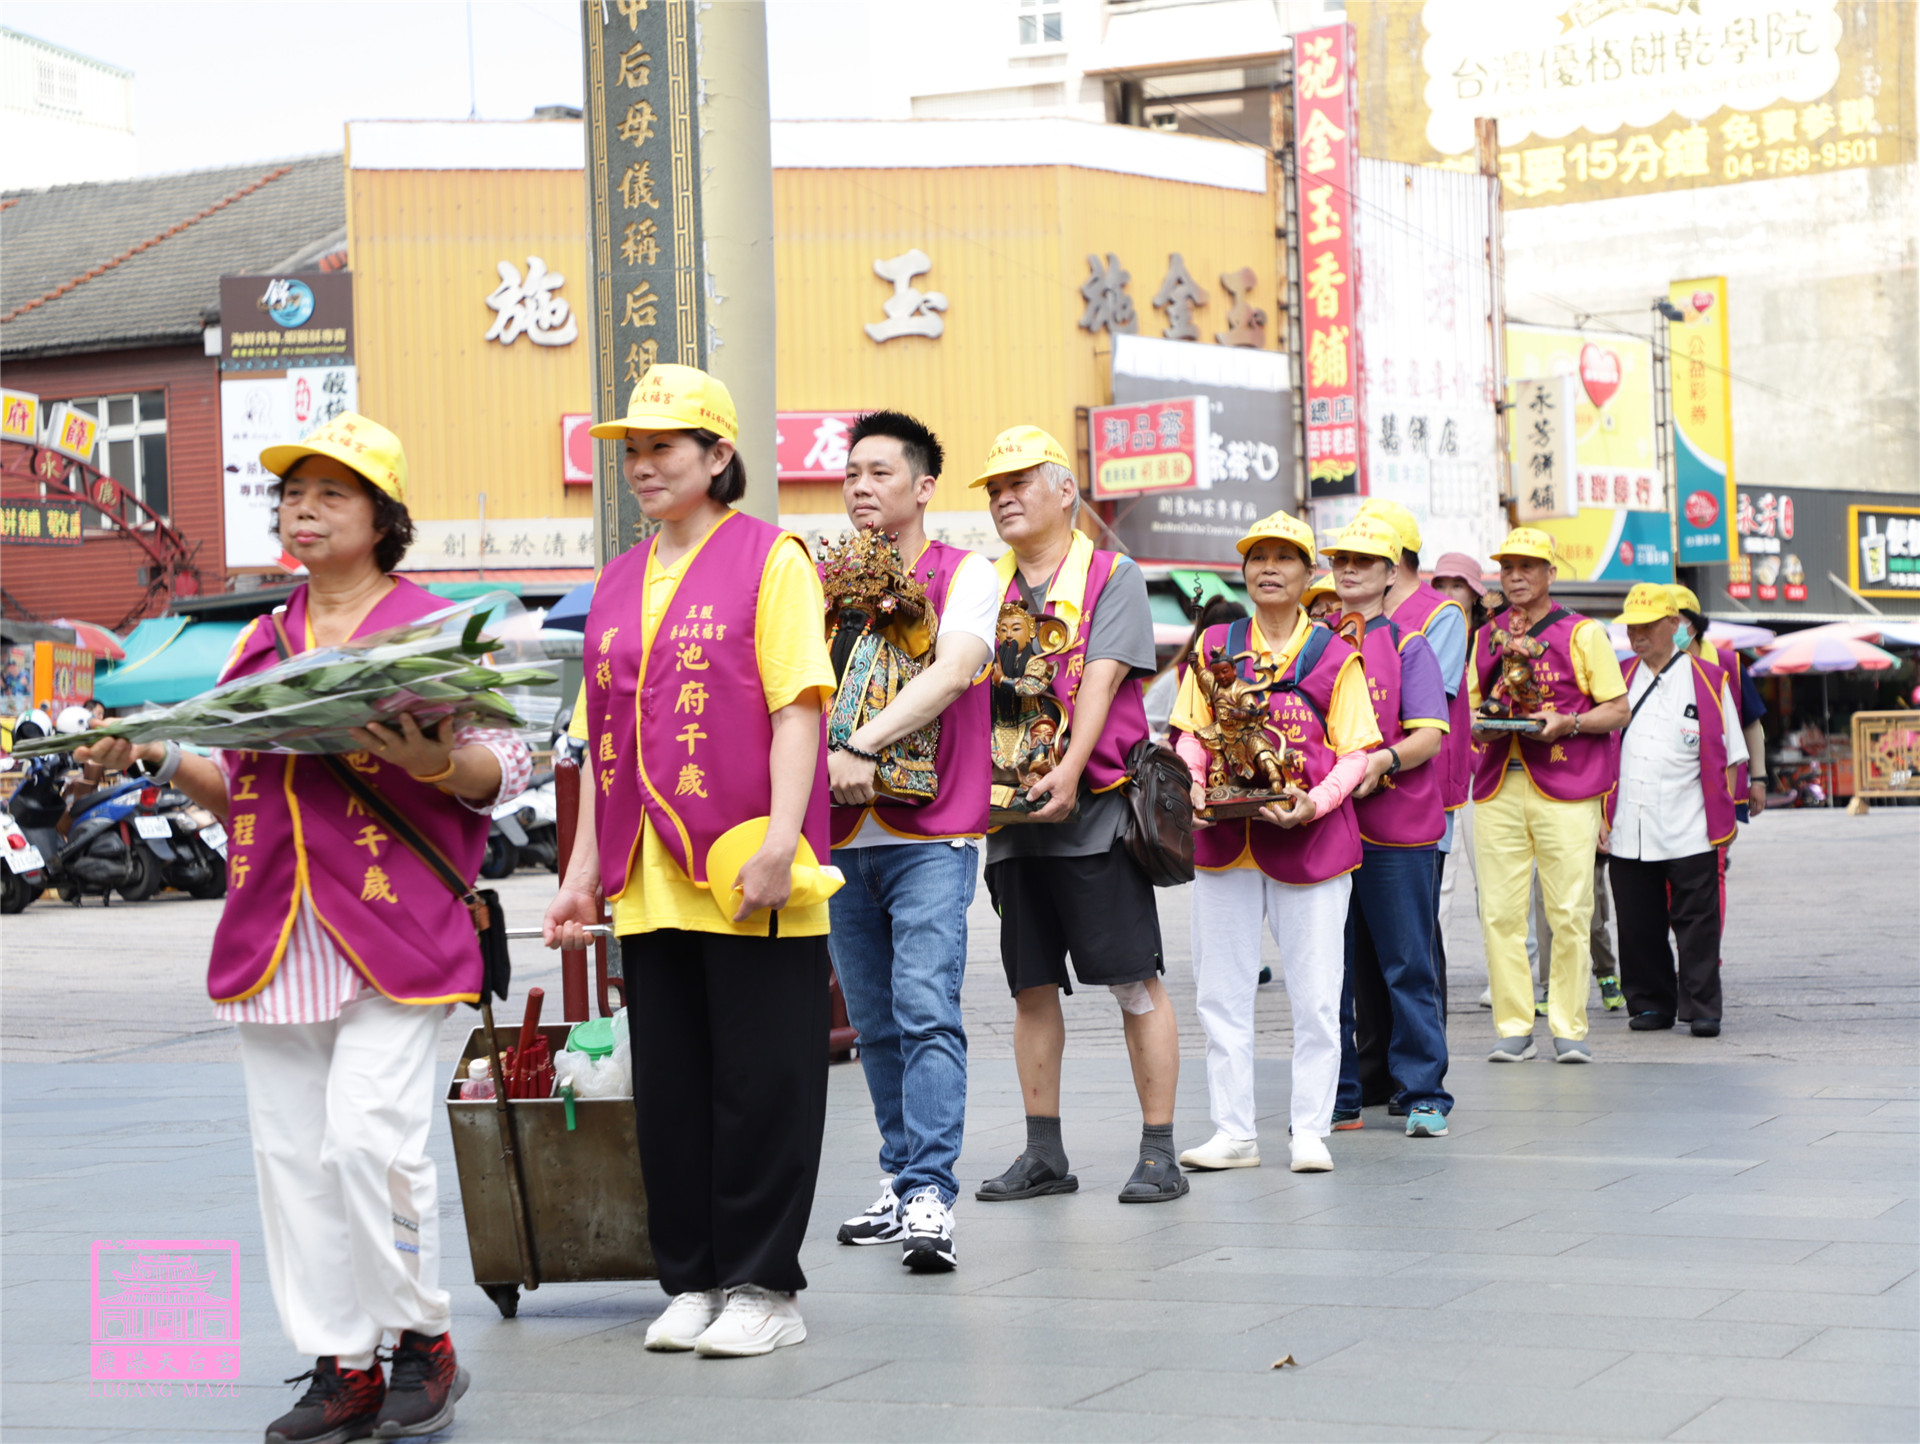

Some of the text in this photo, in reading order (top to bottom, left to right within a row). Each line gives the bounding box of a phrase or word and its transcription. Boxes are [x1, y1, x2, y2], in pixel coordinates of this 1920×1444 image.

[1720, 97, 1876, 151] 免費參觀
[1723, 138, 1878, 180] 04-758-9501
[1299, 36, 1350, 388] 施金玉香鋪
[486, 248, 948, 347] 施 玉
[1079, 252, 1268, 348] 施金玉
[6, 401, 30, 433] 府
[1104, 409, 1185, 453] 御品齋
[1310, 397, 1354, 424] 總店
[40, 451, 61, 479] 永
[1528, 384, 1558, 513] 永芳餅鋪
[669, 624, 728, 642] 泰山天福宮
[685, 605, 714, 620] 五股
[674, 642, 711, 799] 池府千歲
